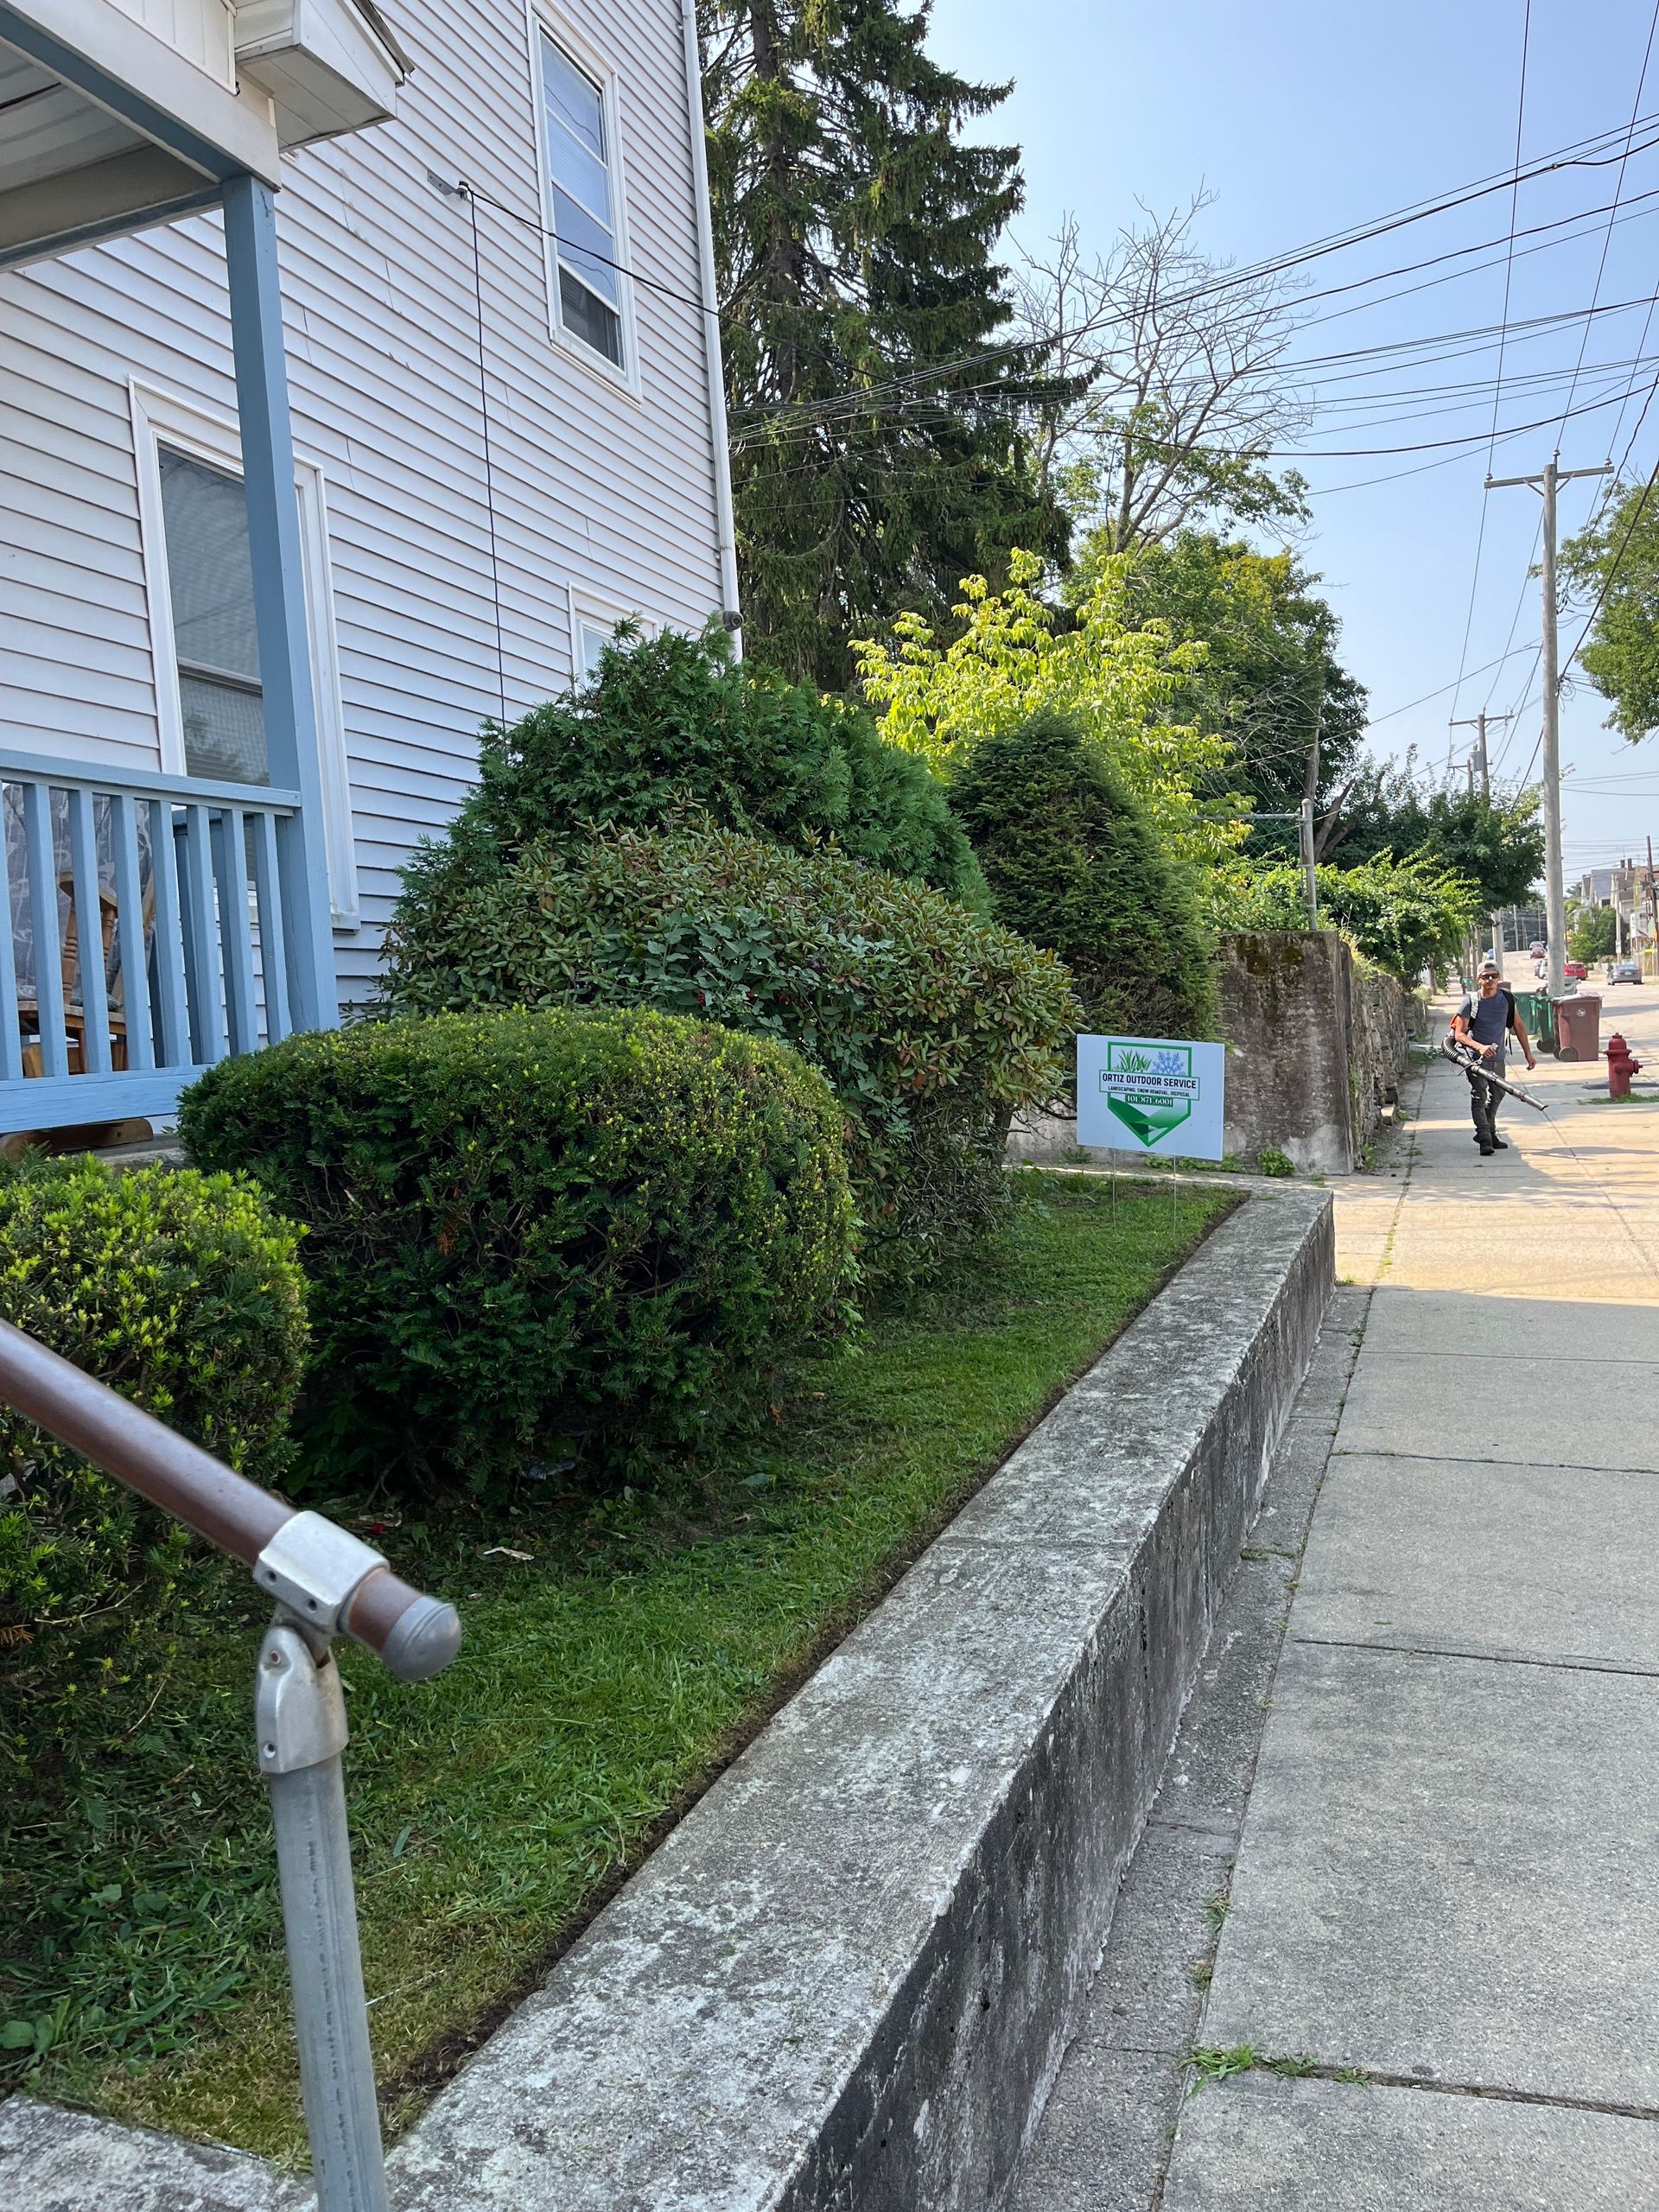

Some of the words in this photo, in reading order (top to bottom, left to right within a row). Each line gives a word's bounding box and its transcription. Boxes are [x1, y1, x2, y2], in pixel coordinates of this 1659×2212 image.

[1103, 1073, 1124, 1083] ORTIZ
[1126, 1076, 1161, 1085] OUTDOOR
[1164, 1077, 1197, 1089] SERVICE
